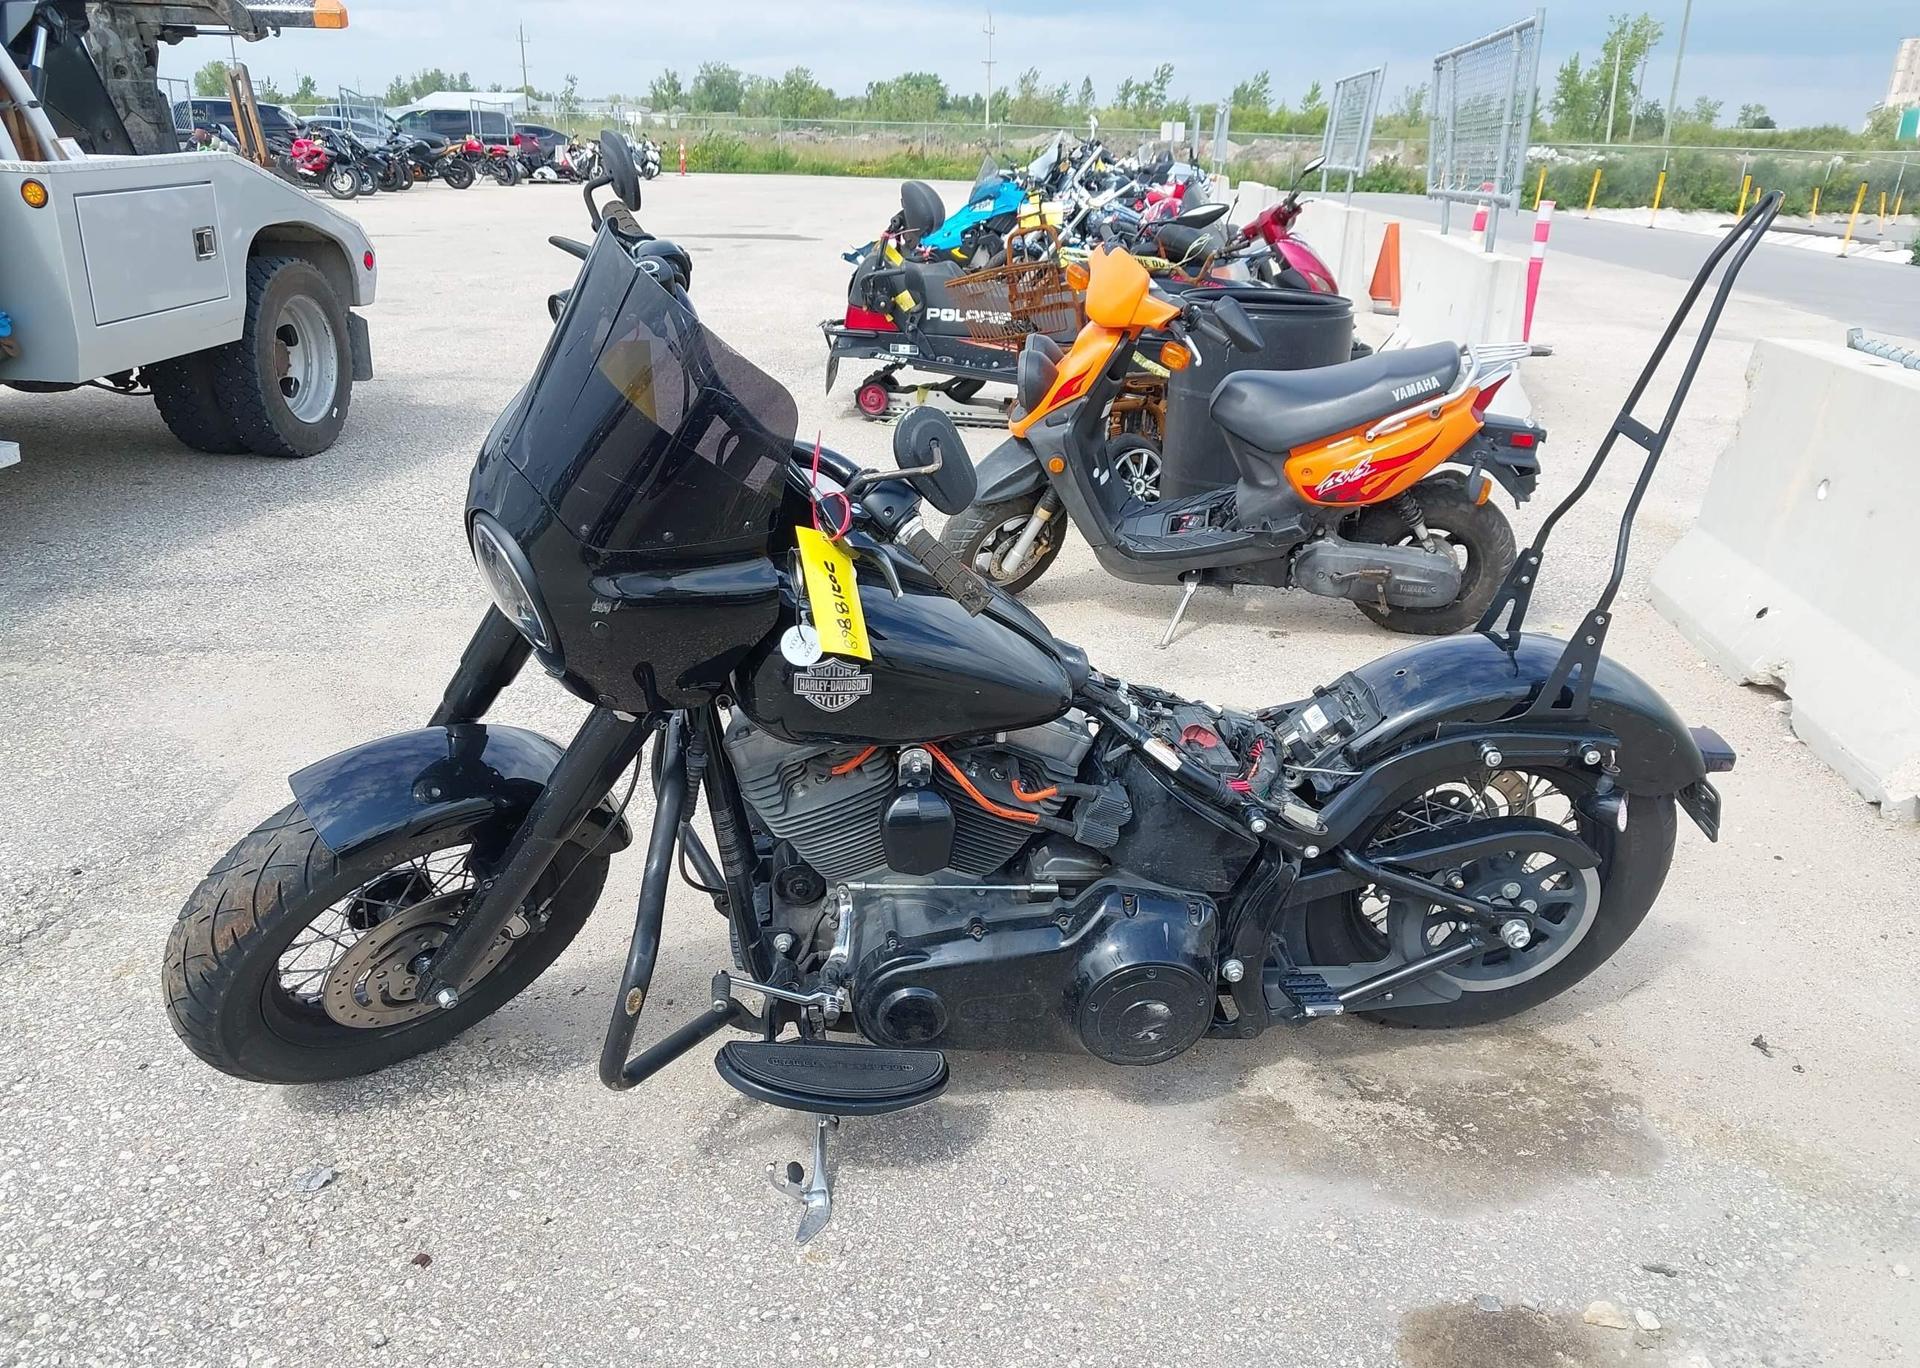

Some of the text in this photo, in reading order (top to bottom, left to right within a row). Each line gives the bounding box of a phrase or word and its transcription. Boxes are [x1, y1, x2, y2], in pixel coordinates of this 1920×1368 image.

[926, 307, 1012, 325] POLARIS
[1391, 375, 1441, 402] YAMAHA
[815, 665, 852, 677] MOTOR
[799, 678, 867, 692] HARLEY-DAVIDSON
[814, 694, 851, 708] CYCLES
